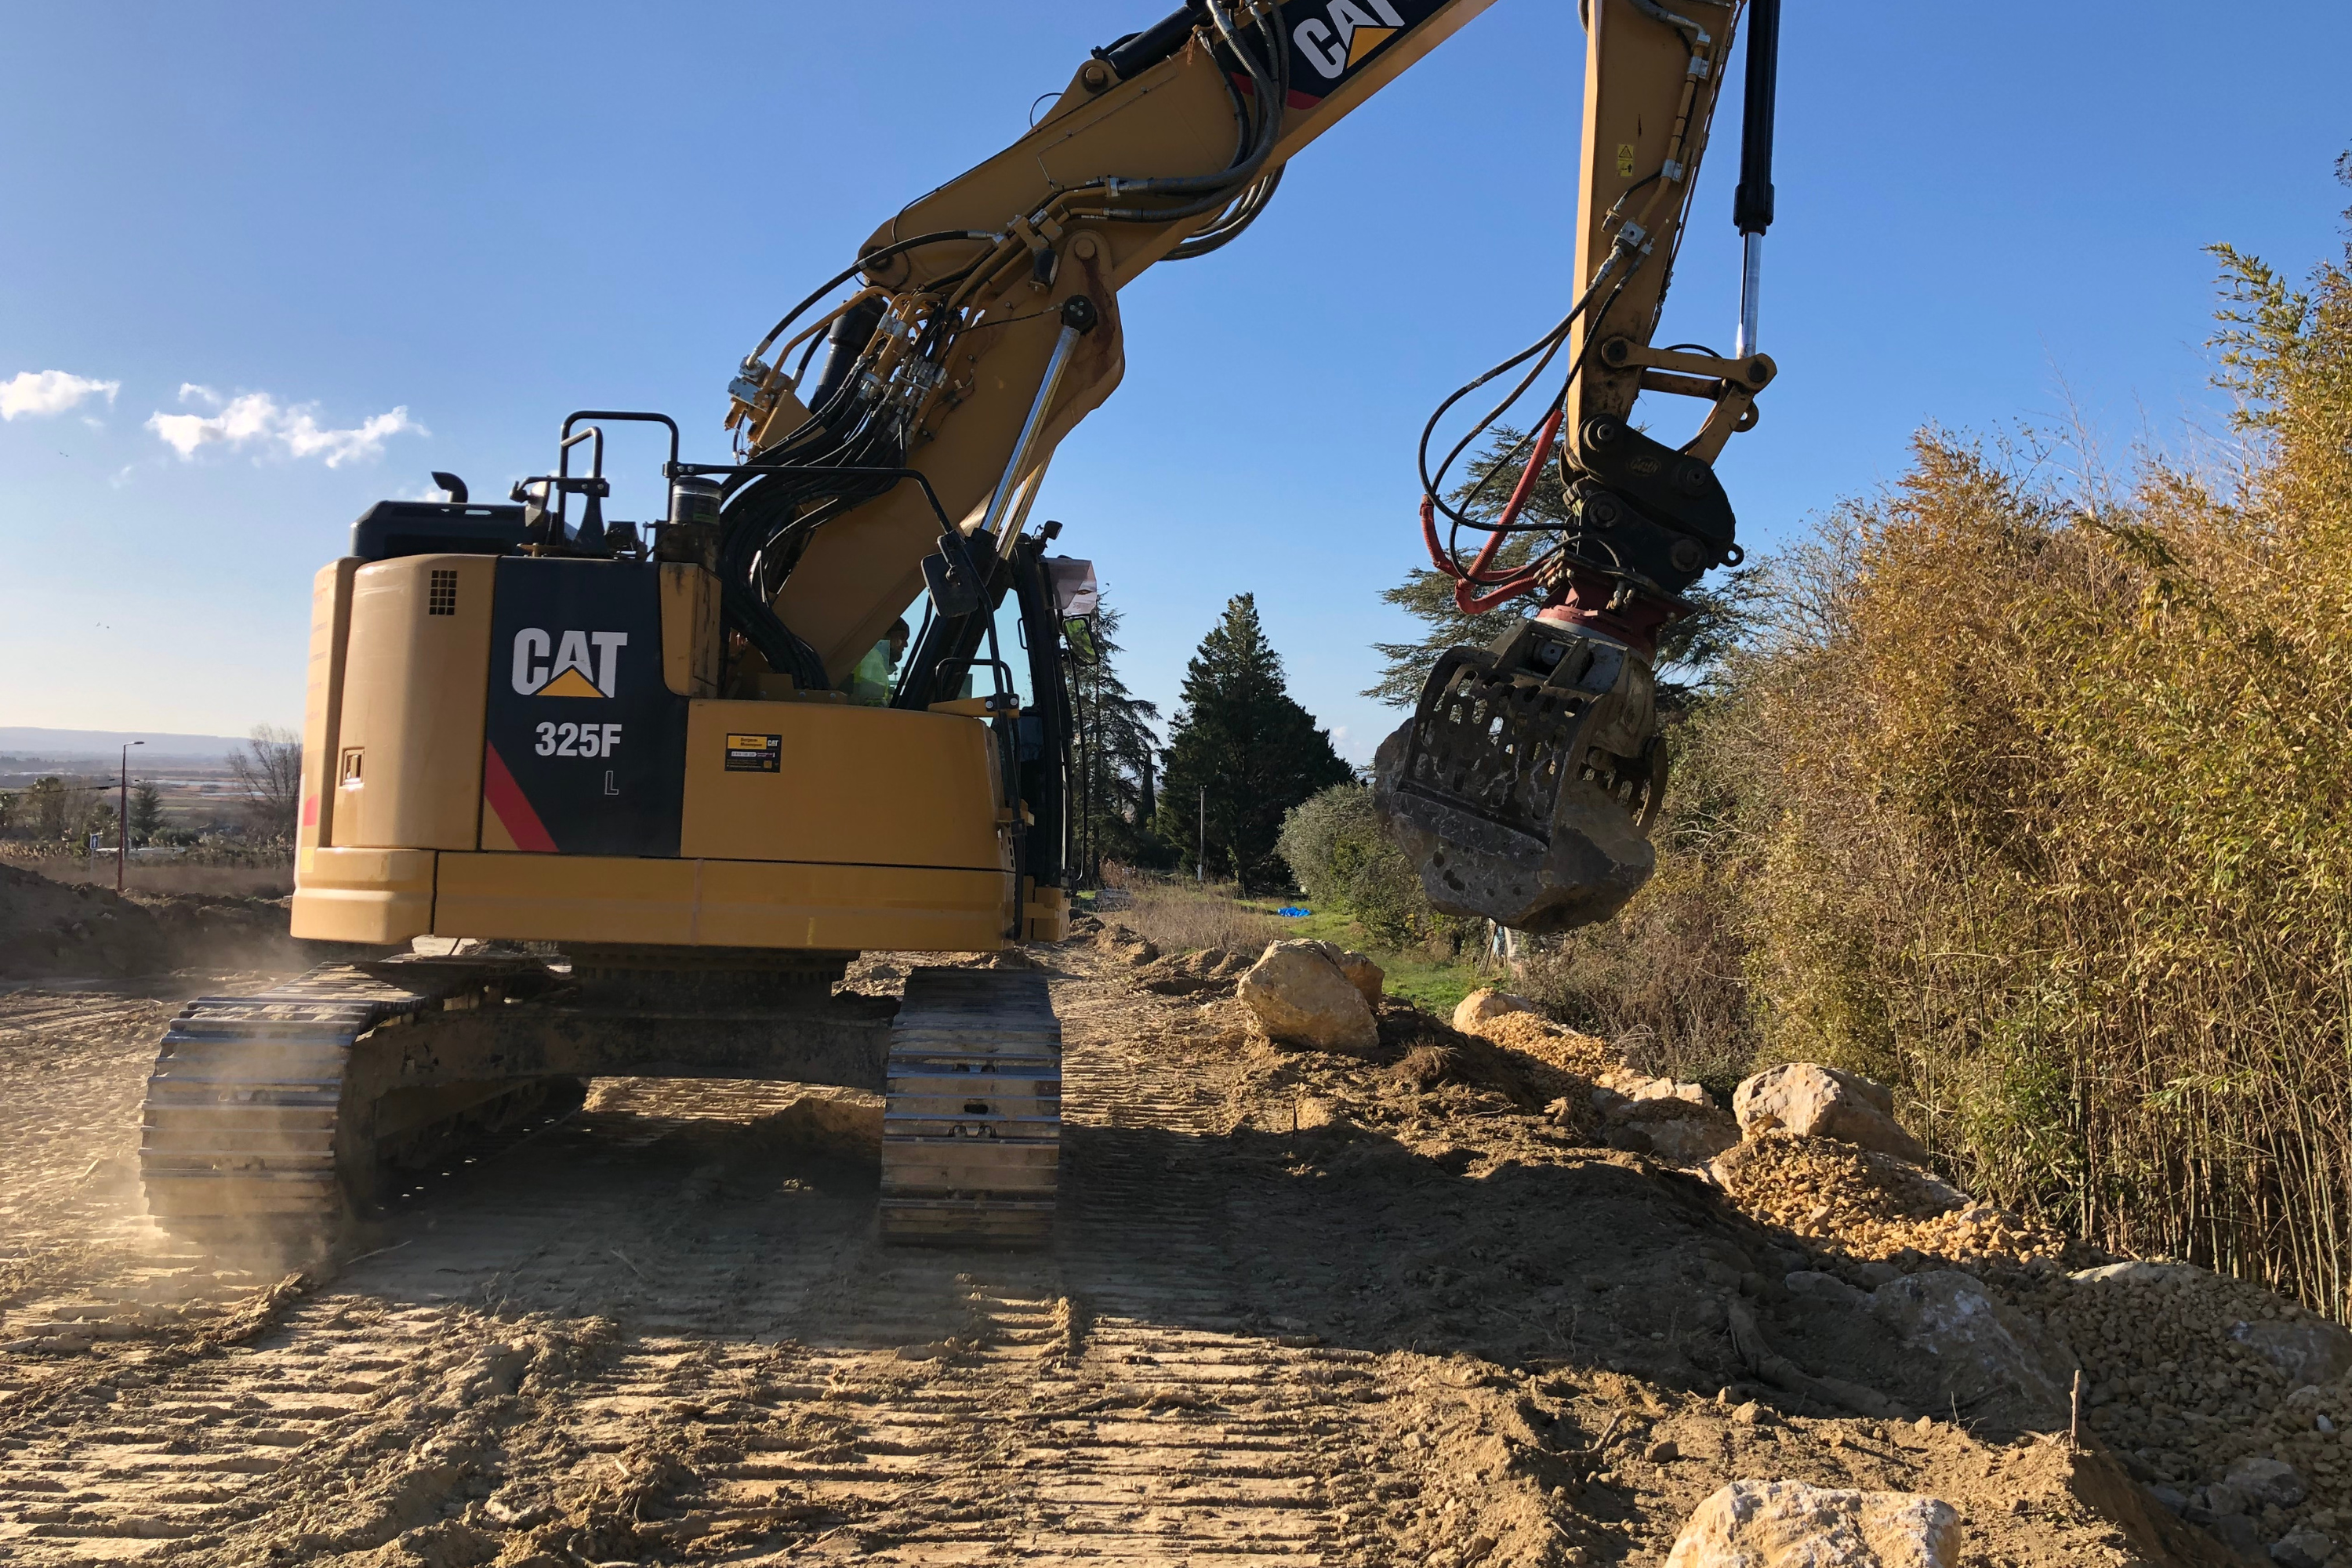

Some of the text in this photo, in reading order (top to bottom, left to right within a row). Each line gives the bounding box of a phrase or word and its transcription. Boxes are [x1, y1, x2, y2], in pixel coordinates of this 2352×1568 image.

[512, 627, 628, 699] CAT
[535, 721, 622, 757] 325F
[604, 770, 619, 795] L
